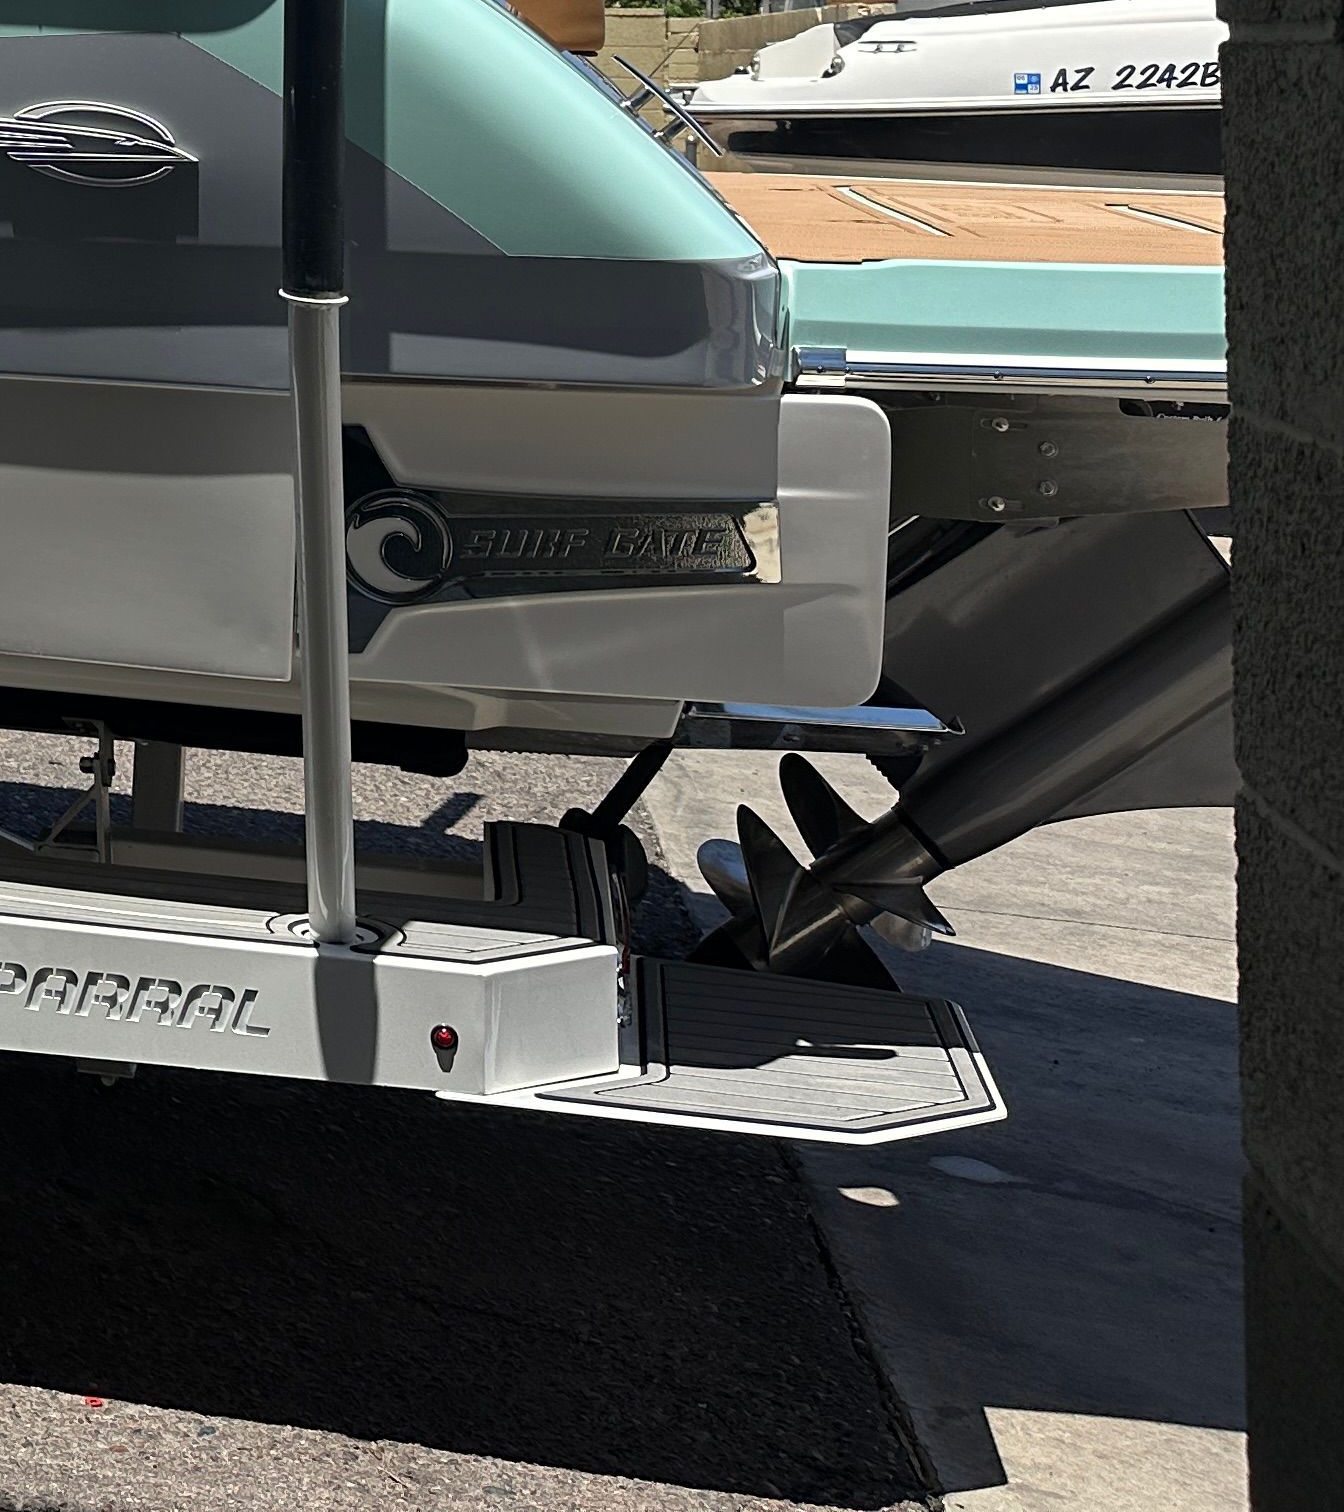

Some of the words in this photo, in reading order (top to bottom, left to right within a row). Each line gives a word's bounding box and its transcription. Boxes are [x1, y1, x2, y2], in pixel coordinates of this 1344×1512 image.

[1049, 66, 1096, 93] AZ
[460, 529, 589, 559] SURF
[602, 527, 726, 558] GATE
